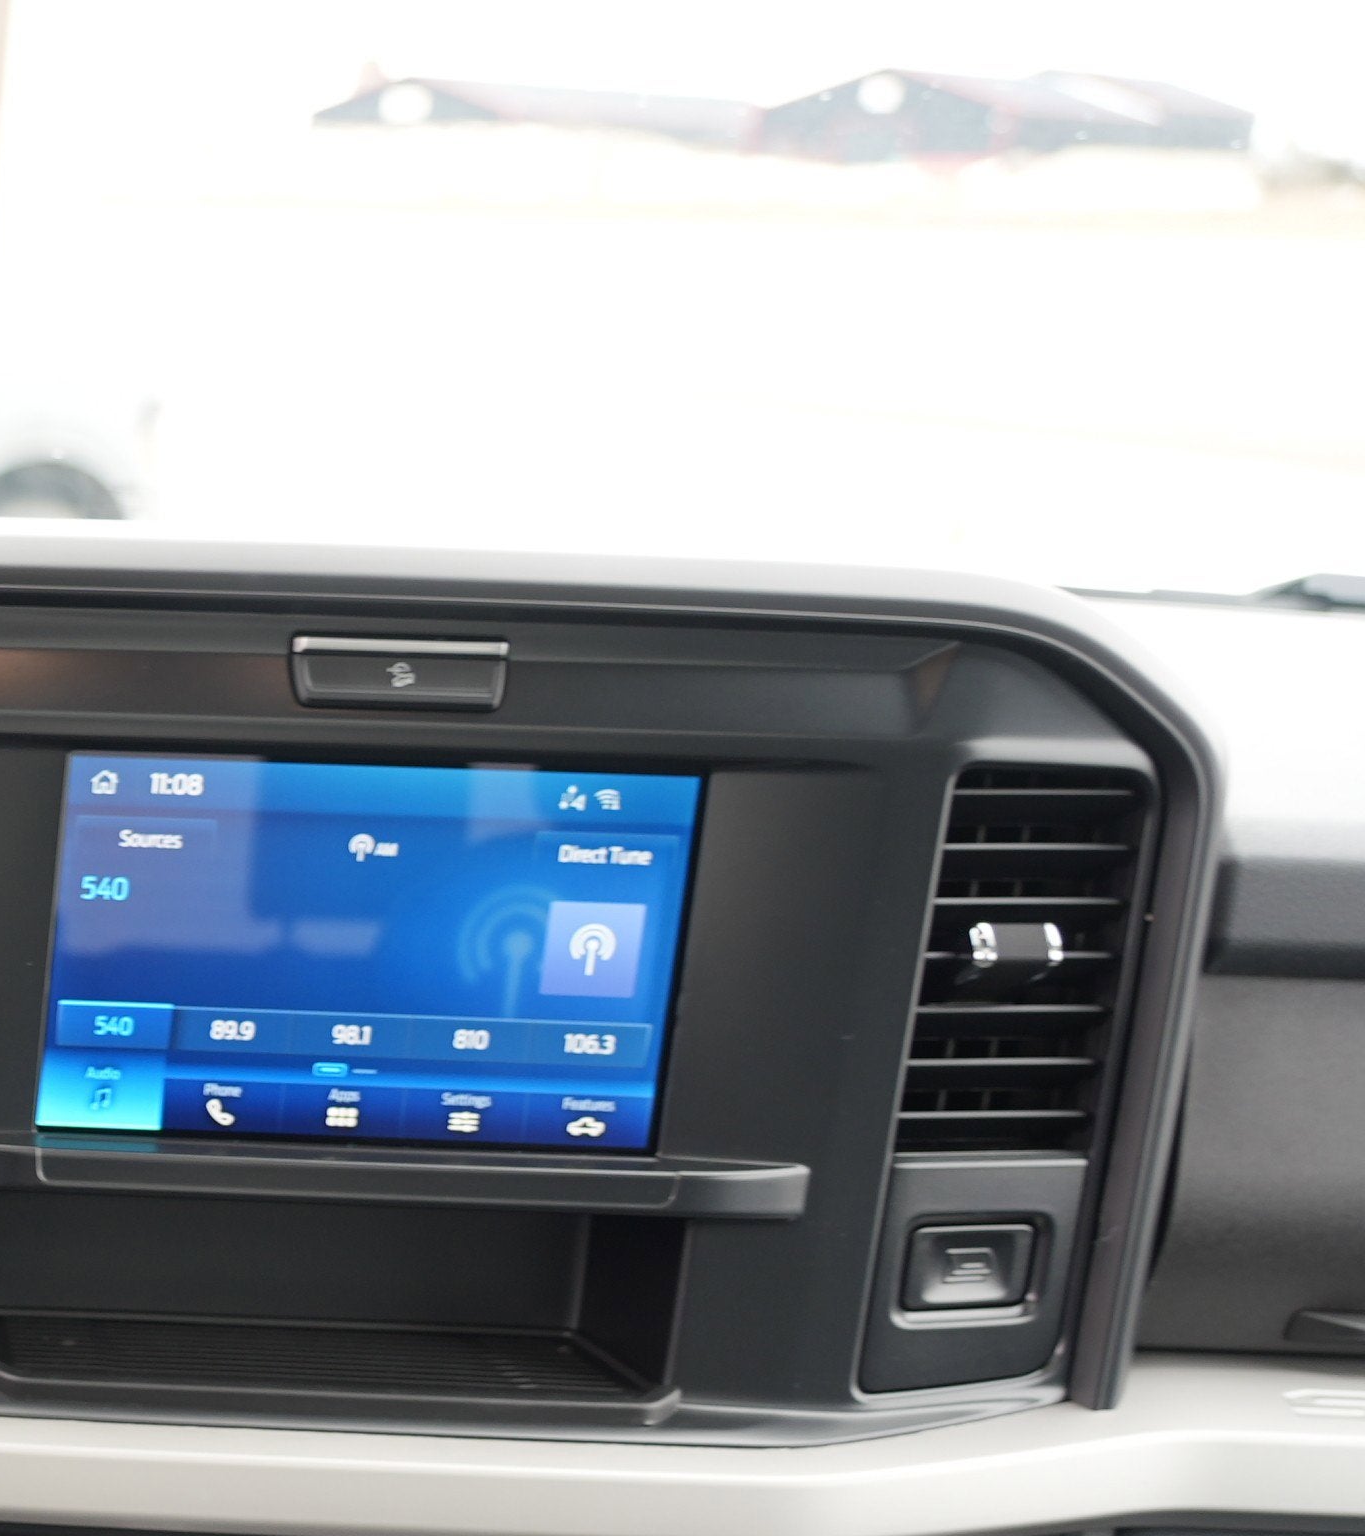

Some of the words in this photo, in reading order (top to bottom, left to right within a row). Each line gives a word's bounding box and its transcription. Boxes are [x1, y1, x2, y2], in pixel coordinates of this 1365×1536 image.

[150, 772, 204, 796] 11:08
[118, 829, 183, 850] Sources
[558, 844, 608, 864] Direct
[609, 845, 653, 866] Tune
[79, 875, 130, 902] 540
[93, 1015, 135, 1037] 540
[209, 1019, 256, 1042] 89.9
[331, 1024, 373, 1046] 98.1
[452, 1028, 490, 1051] 810
[563, 1033, 616, 1055] 106.3
[85, 1066, 121, 1080] Audio
[203, 1083, 242, 1098] Phone
[327, 1088, 361, 1103] Apps
[440, 1092, 492, 1109] Settings
[561, 1097, 616, 1112] Features
